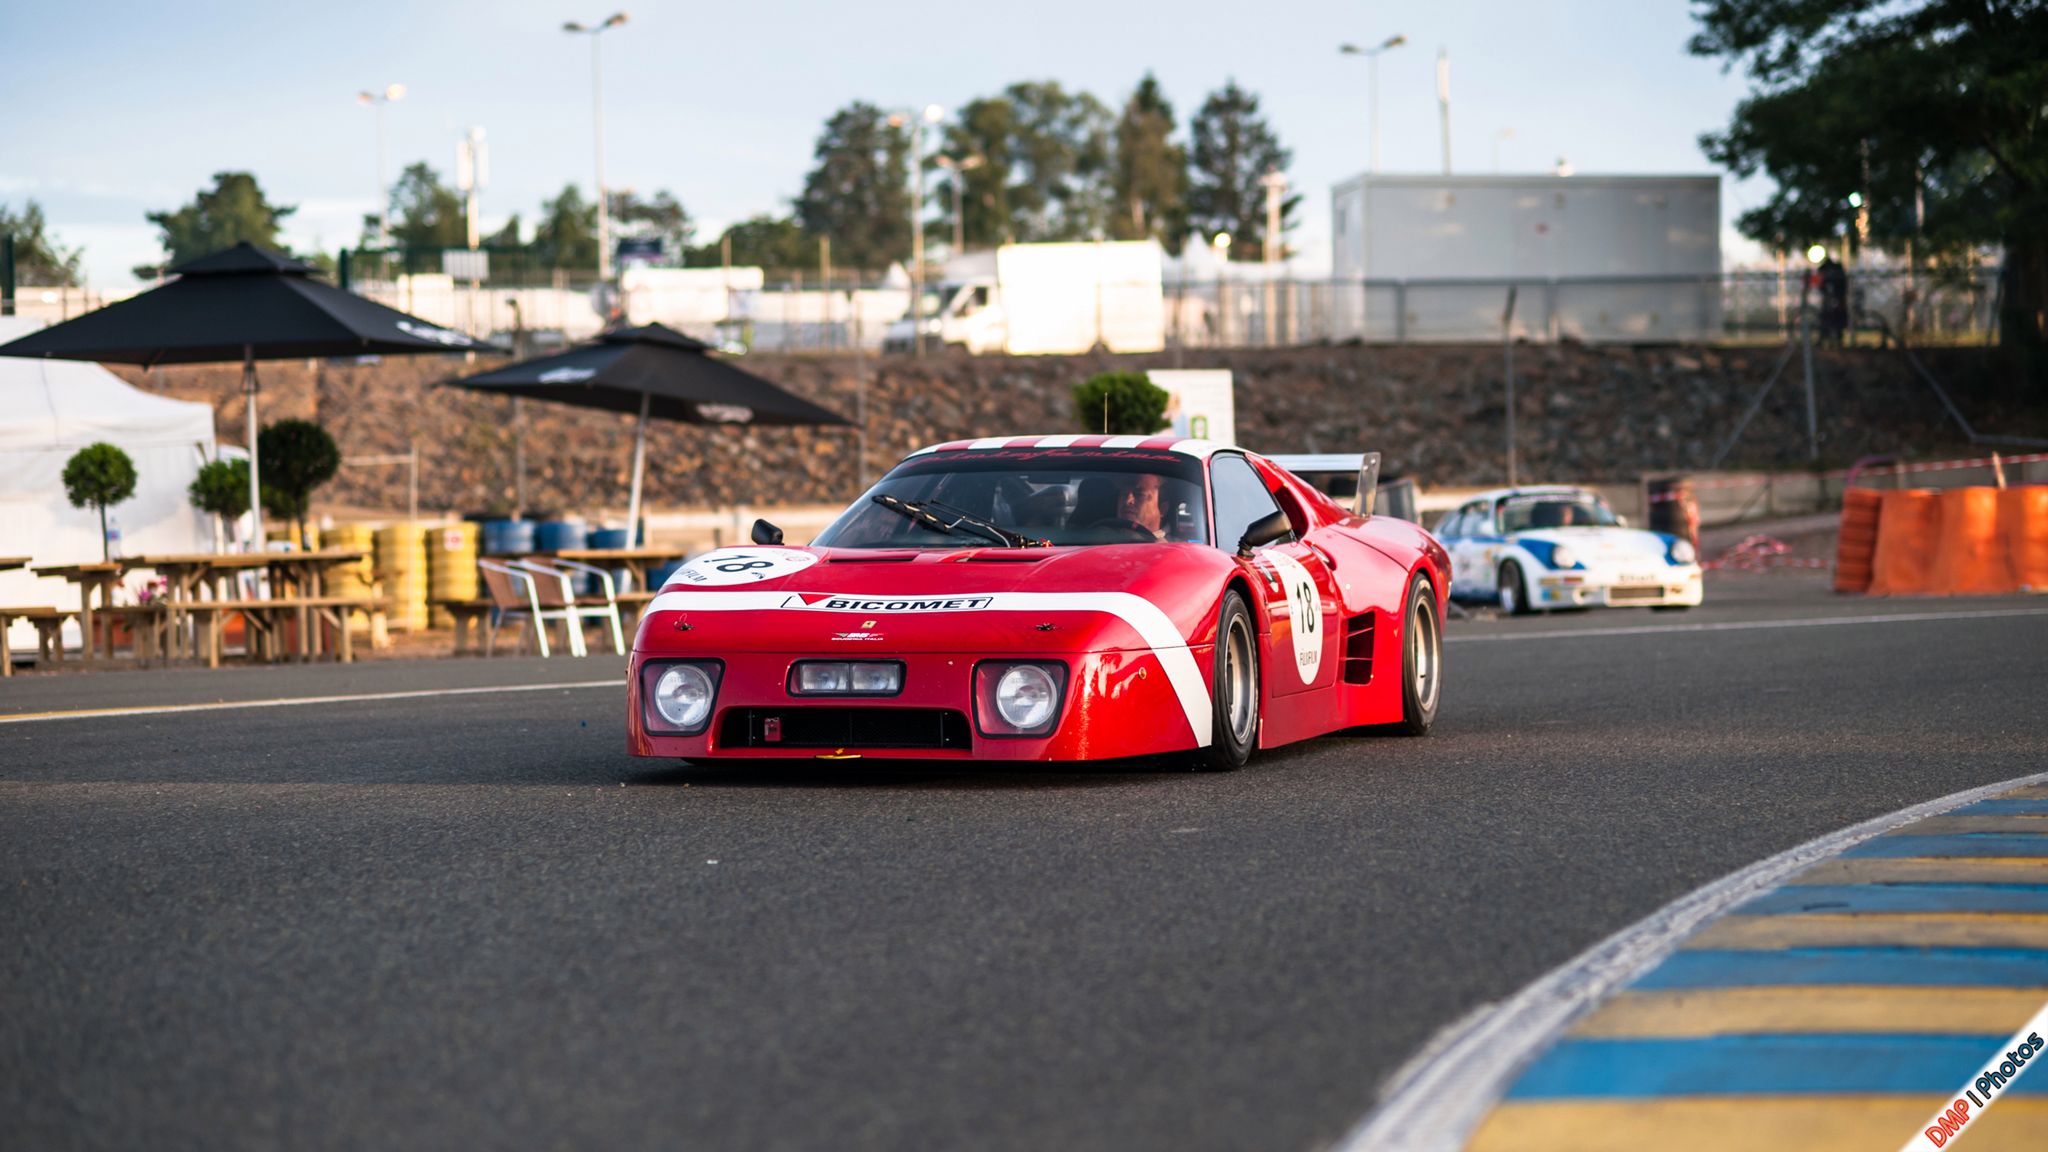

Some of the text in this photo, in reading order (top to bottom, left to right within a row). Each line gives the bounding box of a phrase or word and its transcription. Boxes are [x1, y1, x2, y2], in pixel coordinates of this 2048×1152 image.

[703, 554, 774, 573] 18
[825, 598, 986, 611] BICOMET
[1297, 582, 1315, 633] 18
